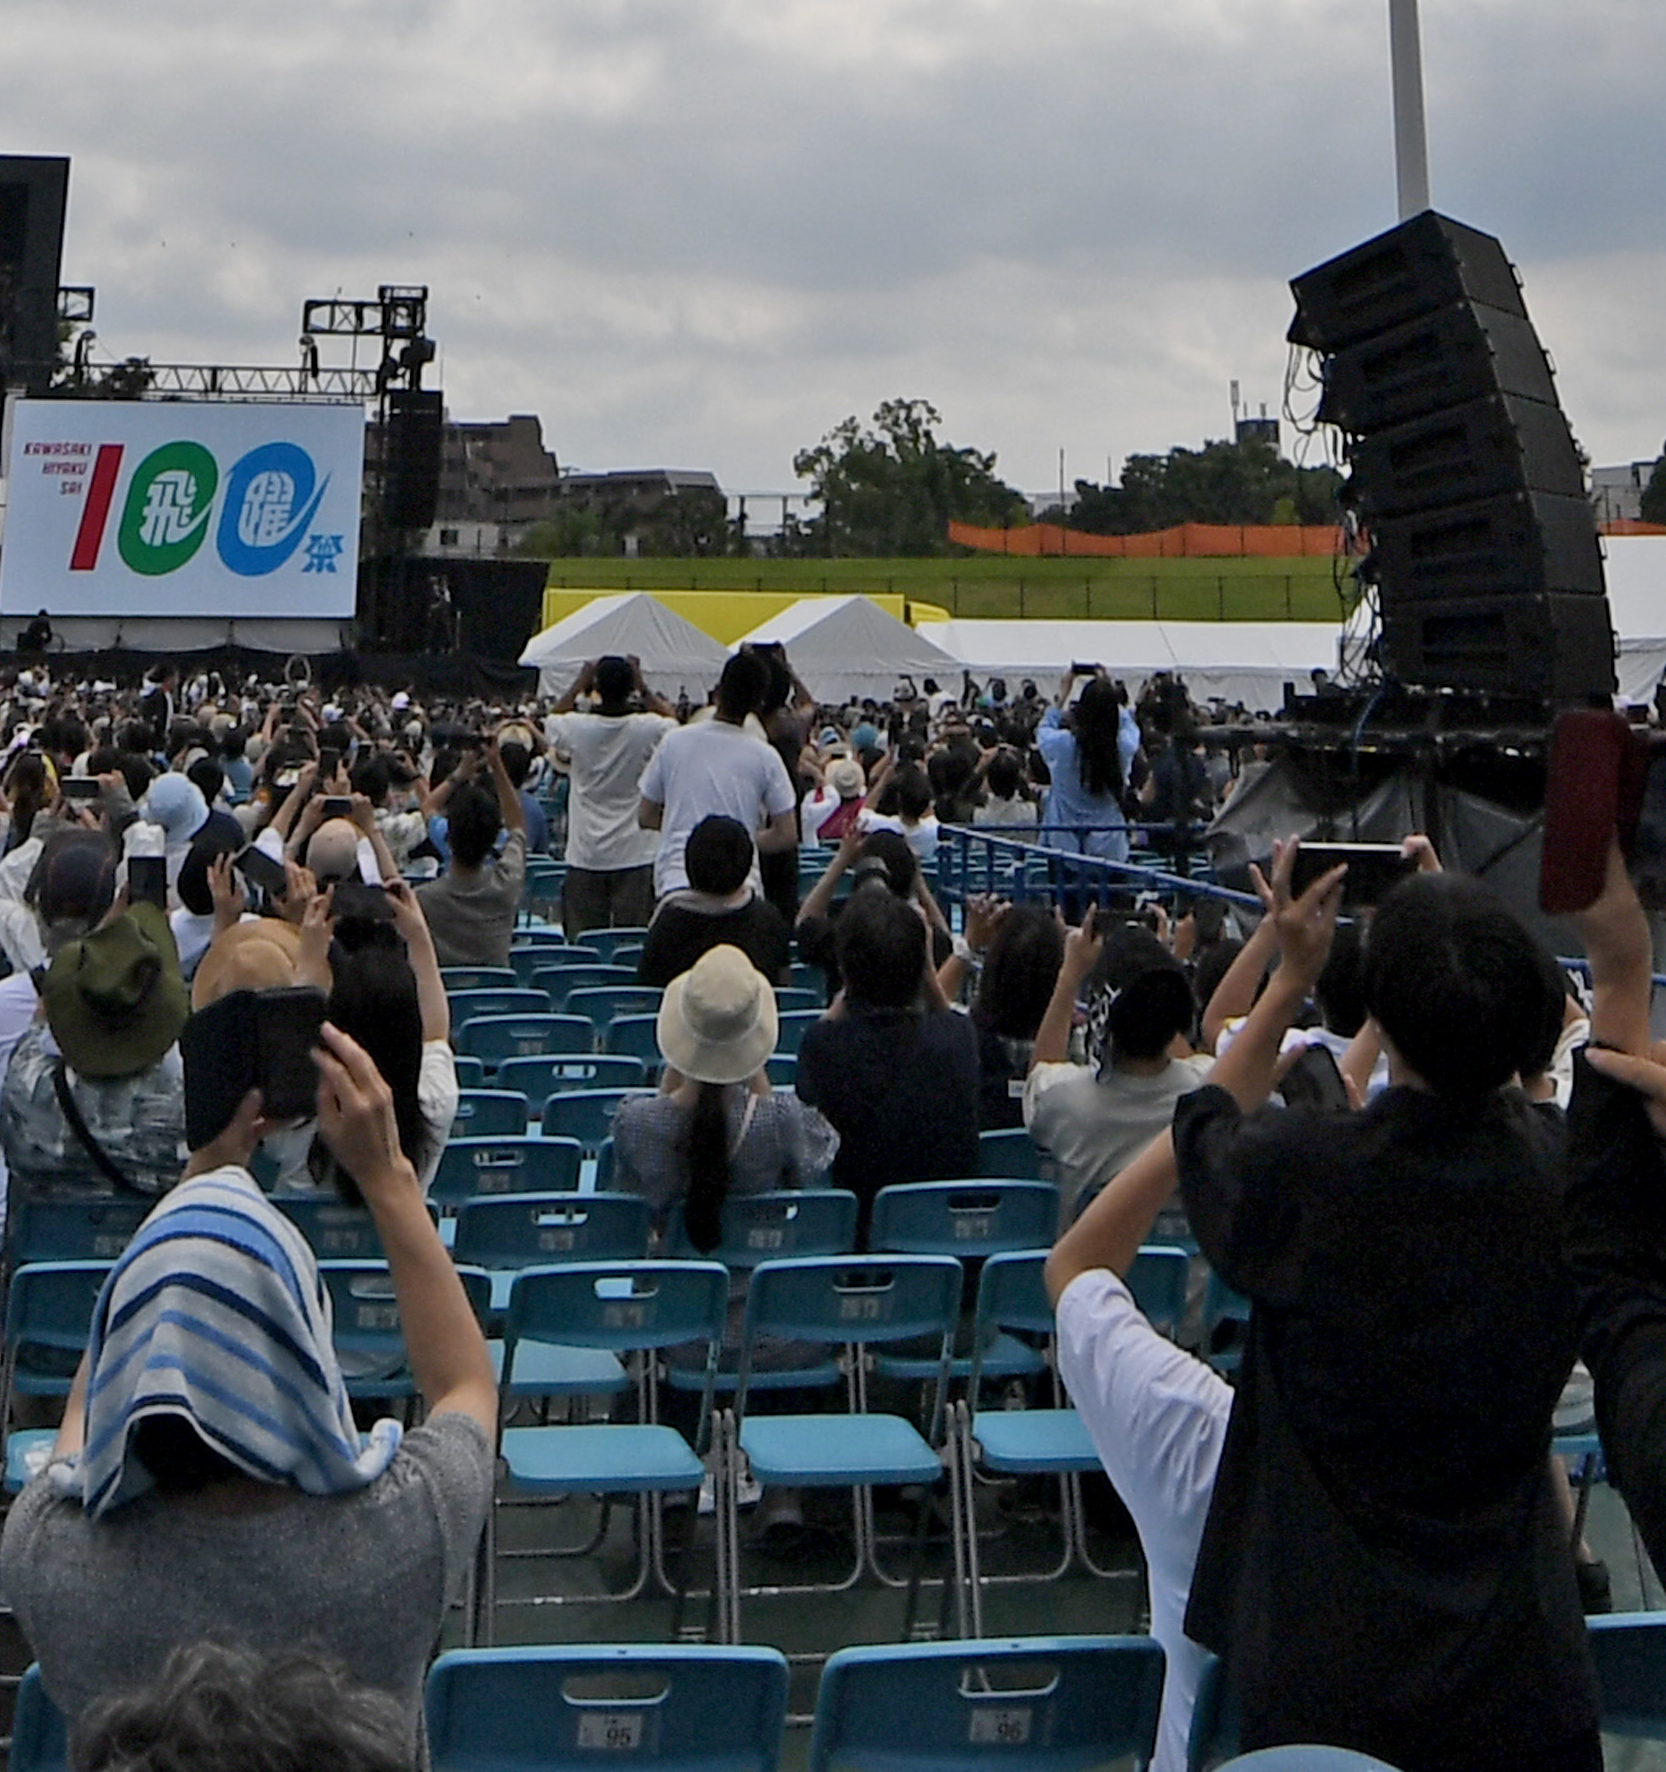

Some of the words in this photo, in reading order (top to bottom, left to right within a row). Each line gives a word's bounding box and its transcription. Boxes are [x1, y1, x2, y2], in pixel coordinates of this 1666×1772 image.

[24, 442, 92, 456] KAWASAKI
[59, 481, 82, 495] SAI
[69, 440, 331, 577] 100
[606, 1727, 632, 1746] 95
